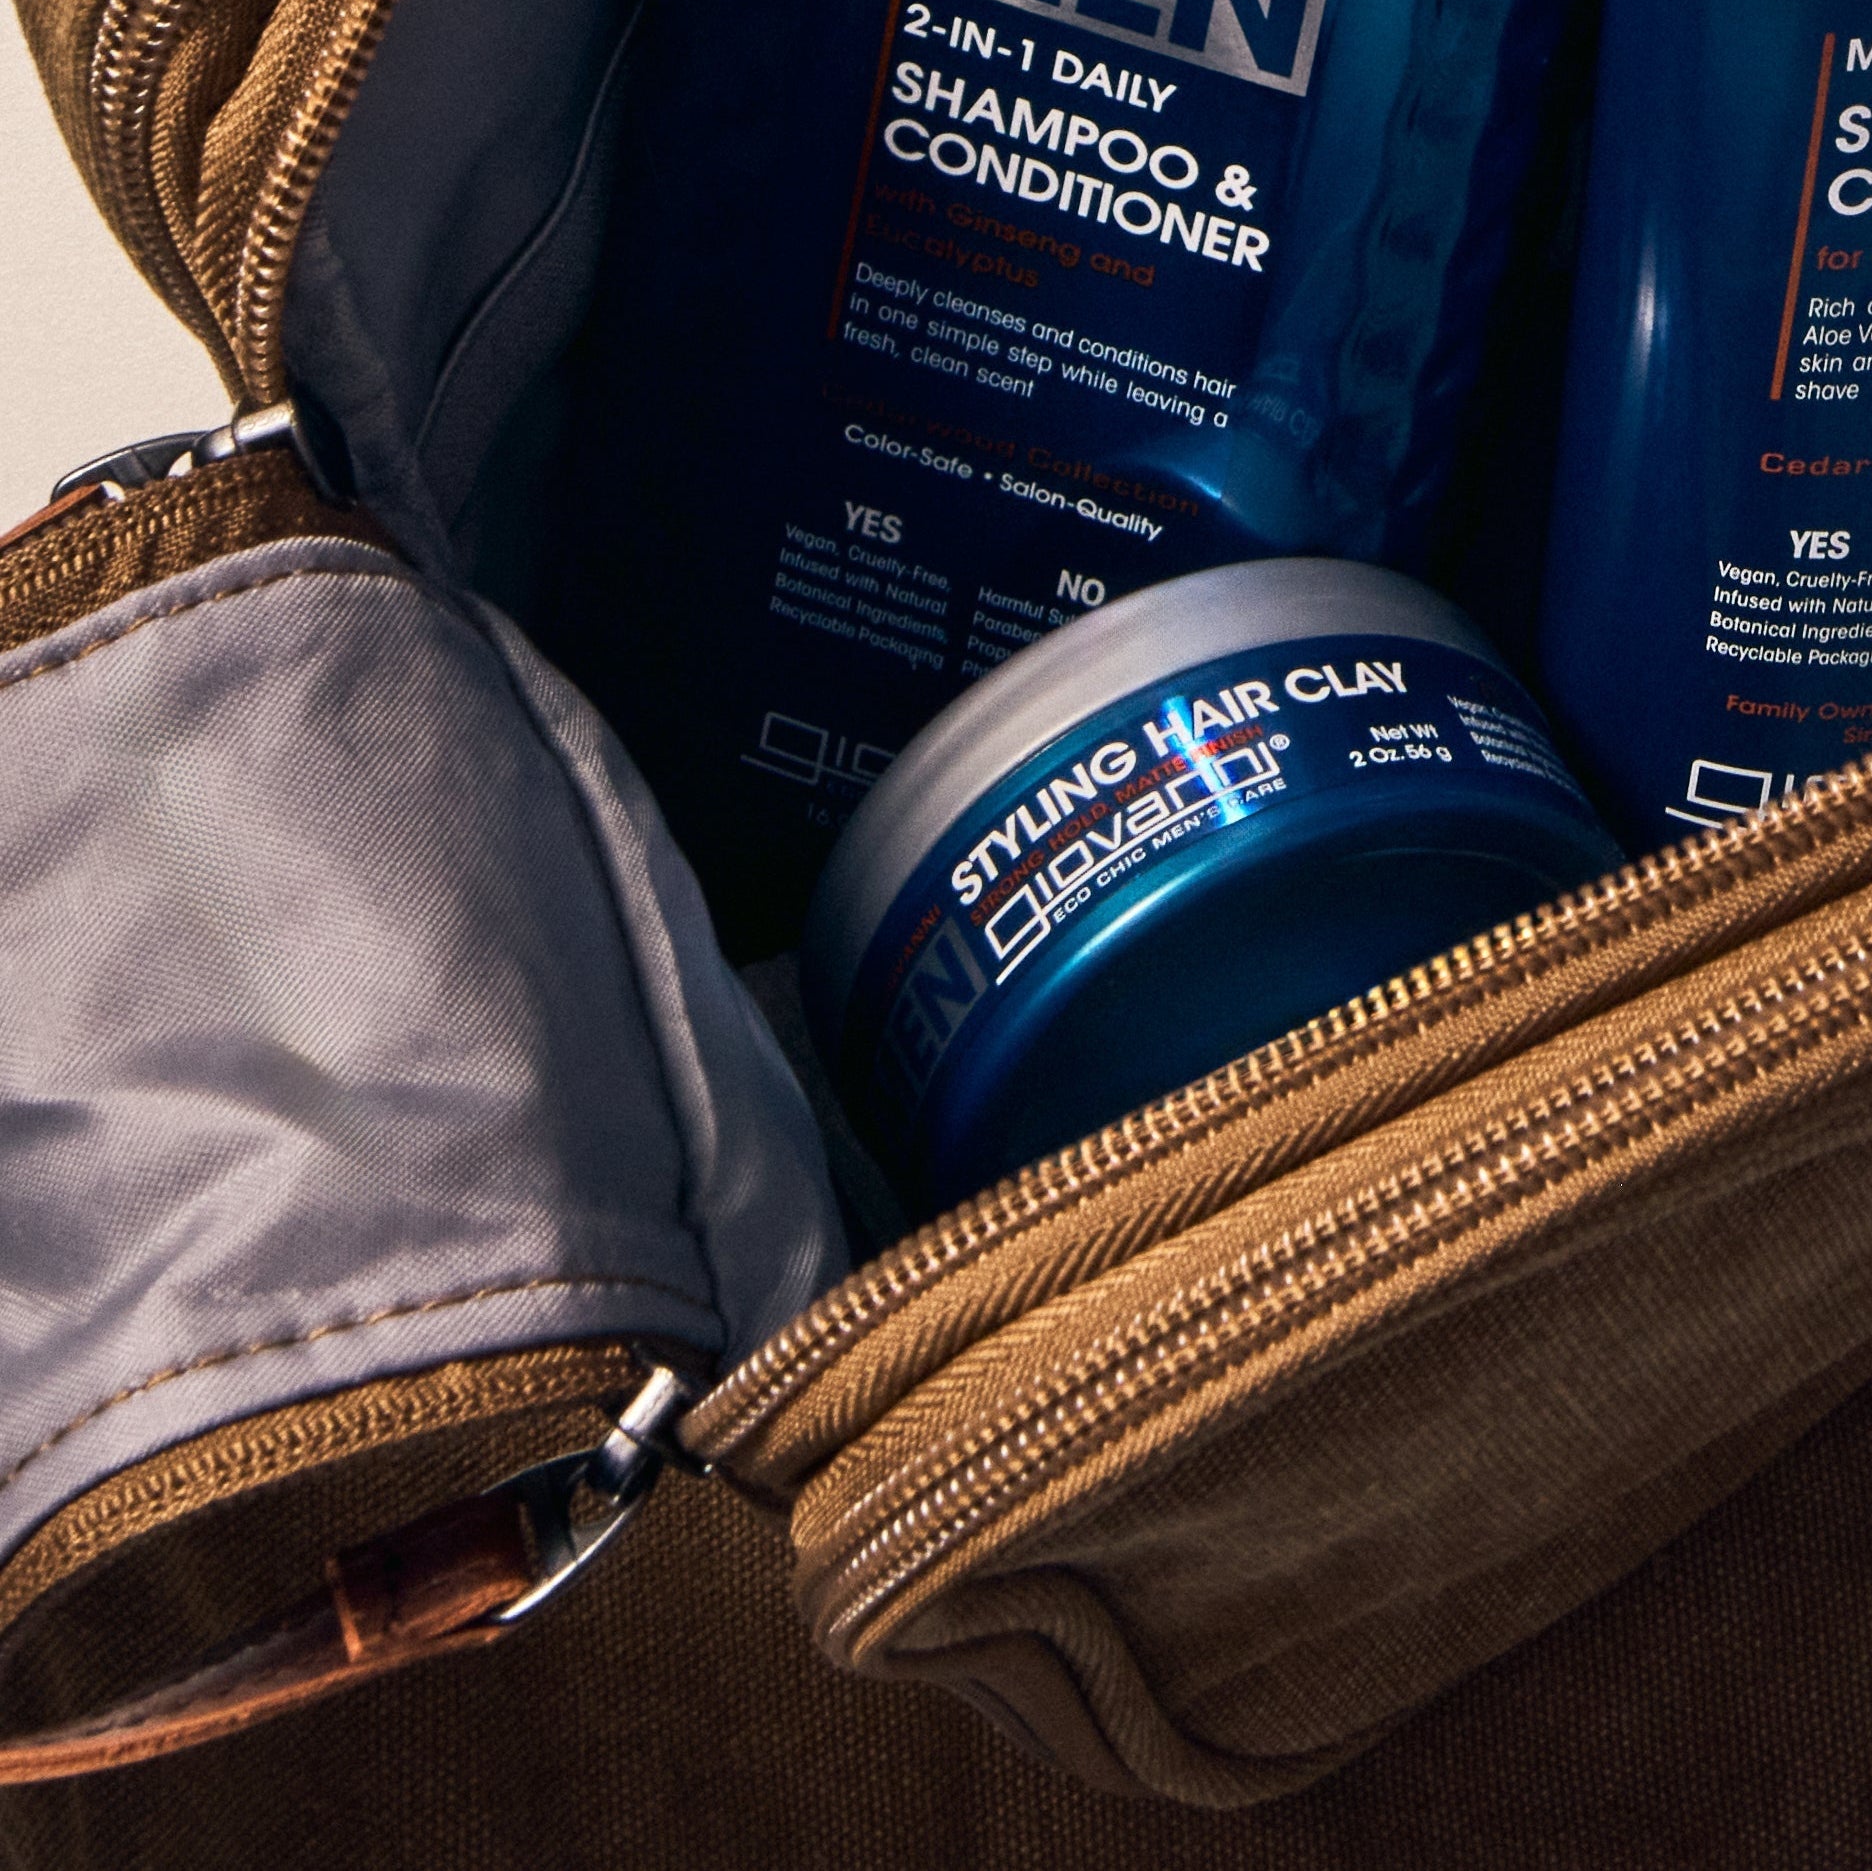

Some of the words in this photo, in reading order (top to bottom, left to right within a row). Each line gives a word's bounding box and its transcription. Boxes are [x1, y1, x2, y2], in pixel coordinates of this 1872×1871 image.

[903, 3, 1035, 72] 2-IN-1
[1052, 49, 1177, 113] DAILY
[892, 61, 1199, 190] SHAMPOO
[1214, 164, 1257, 212] &
[883, 118, 1270, 272] CONDITIONER
[946, 202, 1082, 267] Ginseng
[1089, 252, 1156, 287] and
[1817, 245, 1863, 271] for
[1808, 297, 1856, 318] Rich
[855, 261, 929, 305] Deeply
[932, 291, 1027, 333] cleanses
[1031, 322, 1075, 348] and
[1078, 337, 1188, 385] conditions
[1193, 370, 1237, 399] hair
[1802, 325, 1852, 346] Aloe
[844, 321, 899, 358] fresh,
[910, 346, 969, 377] clean
[976, 367, 1034, 398] scent
[849, 293, 870, 314] in
[878, 305, 919, 330] one
[927, 320, 1000, 356] simple
[1007, 346, 1053, 374] step
[1061, 363, 1118, 394] while
[1126, 381, 1206, 426] leaving
[1213, 411, 1229, 428] a
[1799, 353, 1843, 373] skin
[1795, 381, 1860, 401] shave
[844, 423, 973, 478] Color-Safe
[1000, 472, 1163, 540] Salon-Quality
[844, 500, 903, 544] YES
[1790, 530, 1851, 560] YES
[775, 571, 852, 609] Botanical
[779, 547, 840, 580] Infused
[845, 572, 879, 593] with
[886, 583, 948, 615] Natural
[1056, 568, 1106, 607] NO
[1718, 560, 1780, 587] Vegan,
[769, 595, 855, 637] Recyclable
[978, 586, 1053, 619] Harmful
[1713, 585, 1783, 612] Infused
[1788, 598, 1826, 614] with
[1709, 610, 1797, 638] Botanical
[1705, 635, 1803, 665] Recyclable
[1725, 693, 1810, 723] Family
[1369, 724, 1409, 743] Net
[1409, 723, 1439, 739] Wt
[1349, 750, 1367, 768] 2
[951, 741, 1137, 906] STYLING
[1142, 680, 1280, 758] HAIR
[1284, 661, 1408, 704] CLAY
[970, 851, 1045, 926] STRONG
[1114, 754, 1187, 804] MATTE
[1053, 888, 1091, 923] ECO
[1096, 849, 1147, 887] CHIC
